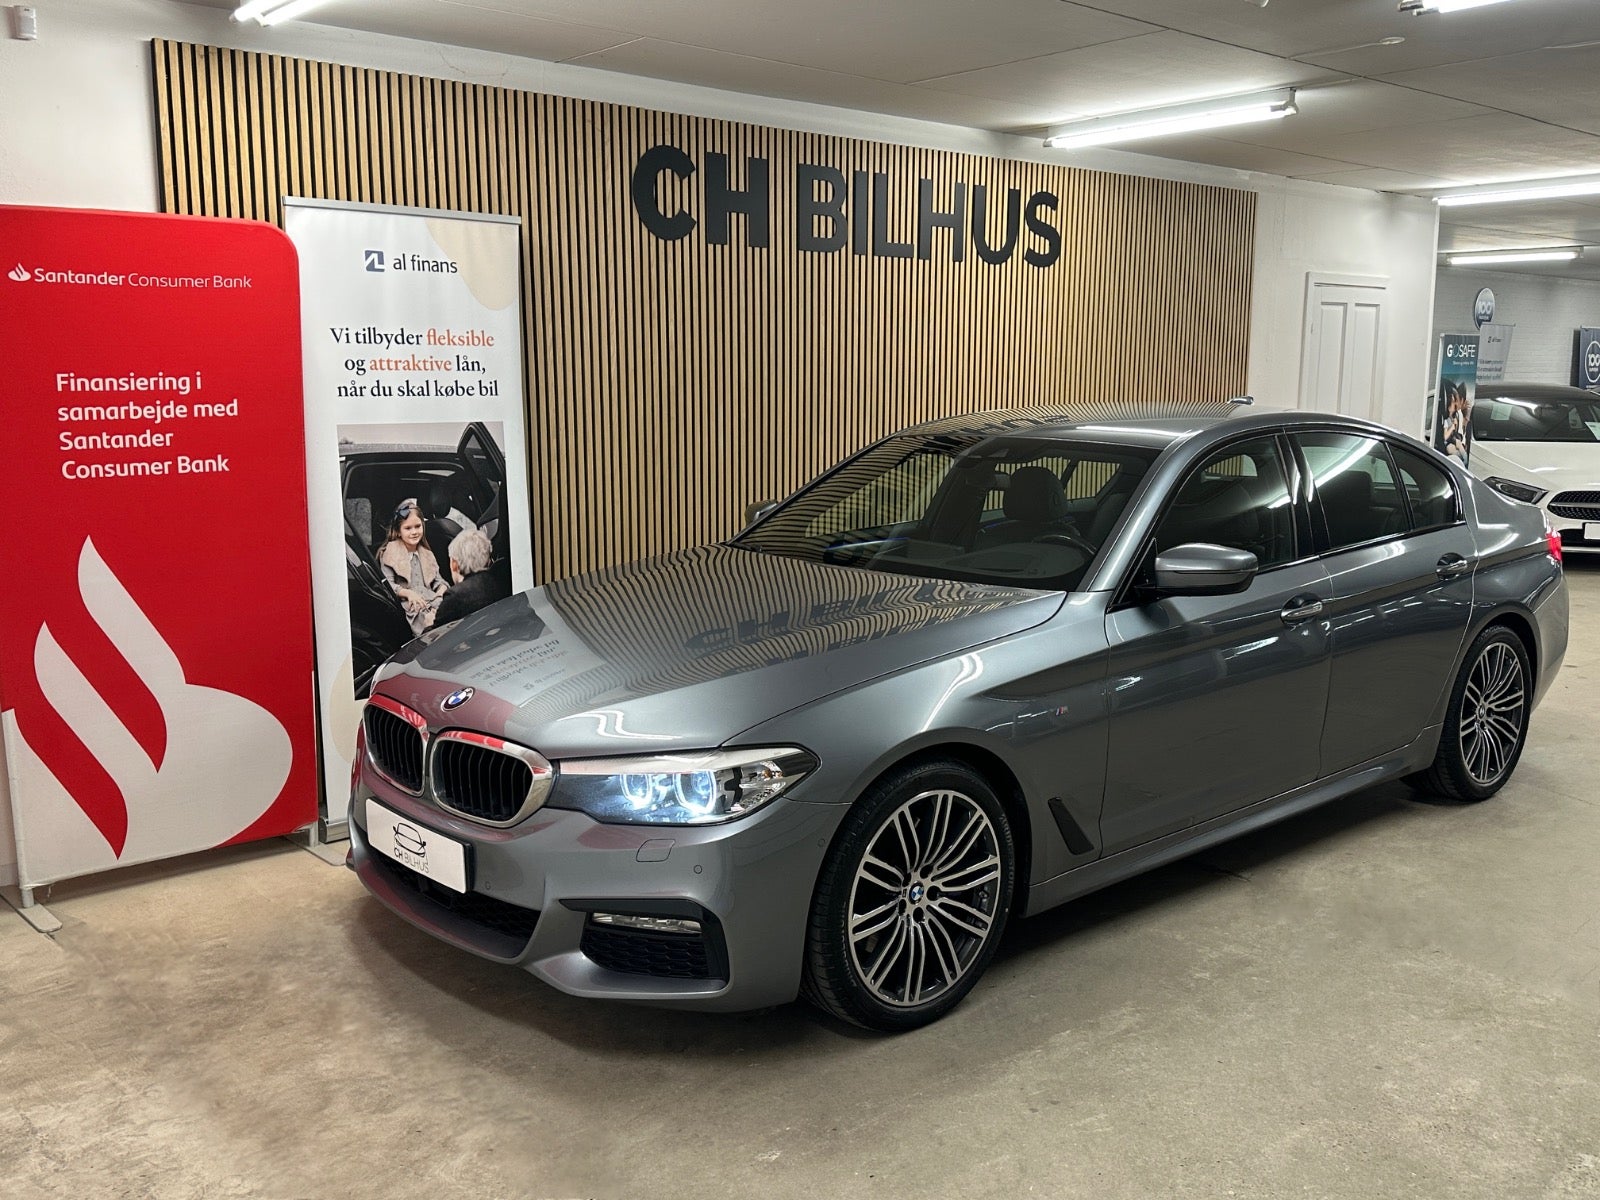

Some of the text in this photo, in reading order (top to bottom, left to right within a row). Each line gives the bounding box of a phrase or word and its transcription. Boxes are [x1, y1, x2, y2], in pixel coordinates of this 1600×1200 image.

[632, 144, 1062, 268] CH BILHUS
[394, 253, 458, 274] al finans
[34, 267, 252, 289] Santander Consumer Bank
[329, 327, 495, 350] Vi tilbyder fleksible
[344, 354, 486, 376] og attraktive lån,
[56, 371, 202, 395] Finansiering i
[337, 379, 499, 398] når du skal købe bil
[57, 398, 238, 425] samarbejde med
[59, 429, 174, 452] Santander
[61, 454, 230, 480] Consumer Bank
[393, 848, 429, 873] CH BILHUS
